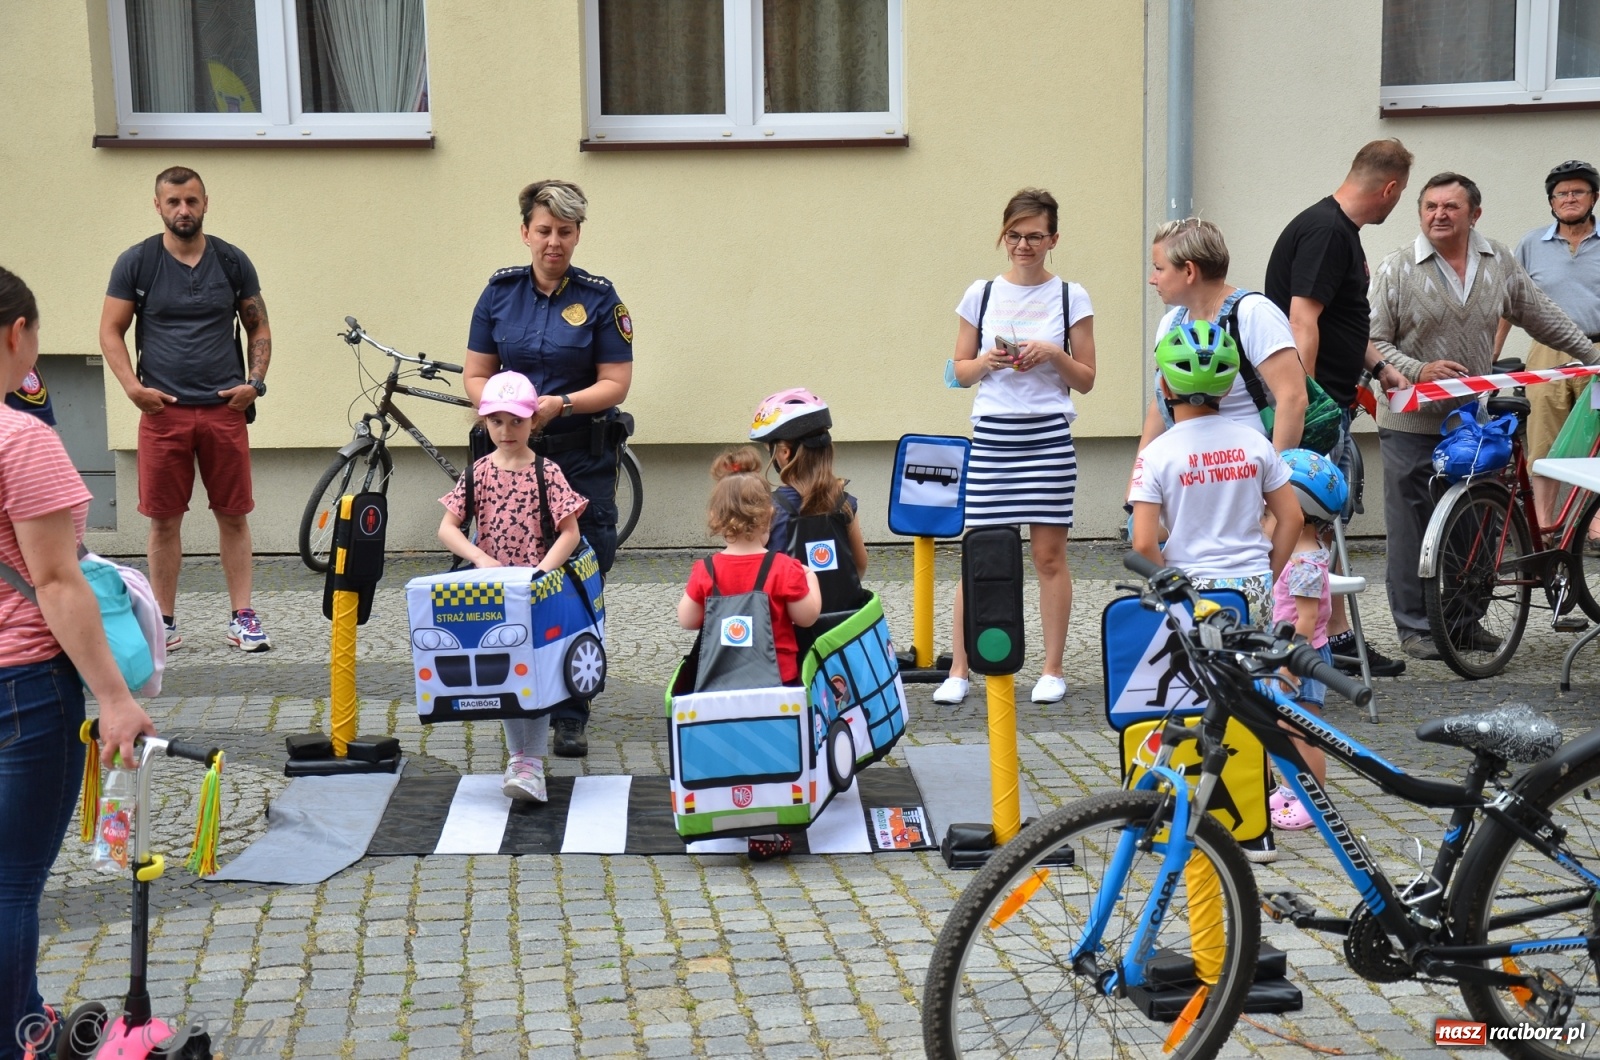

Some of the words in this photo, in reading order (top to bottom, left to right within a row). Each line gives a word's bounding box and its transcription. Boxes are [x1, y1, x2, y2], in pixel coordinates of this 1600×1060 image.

[409, 427, 461, 476] GRAND
[1189, 453, 1198, 468] AP
[1208, 462, 1258, 483] TWORKÓW
[436, 612, 464, 623] STRAŻ
[466, 611, 503, 622] MIEJSKA
[460, 699, 499, 708] RACIBÓRZ
[1296, 772, 1375, 875] author
[1150, 871, 1180, 925] CAPA
